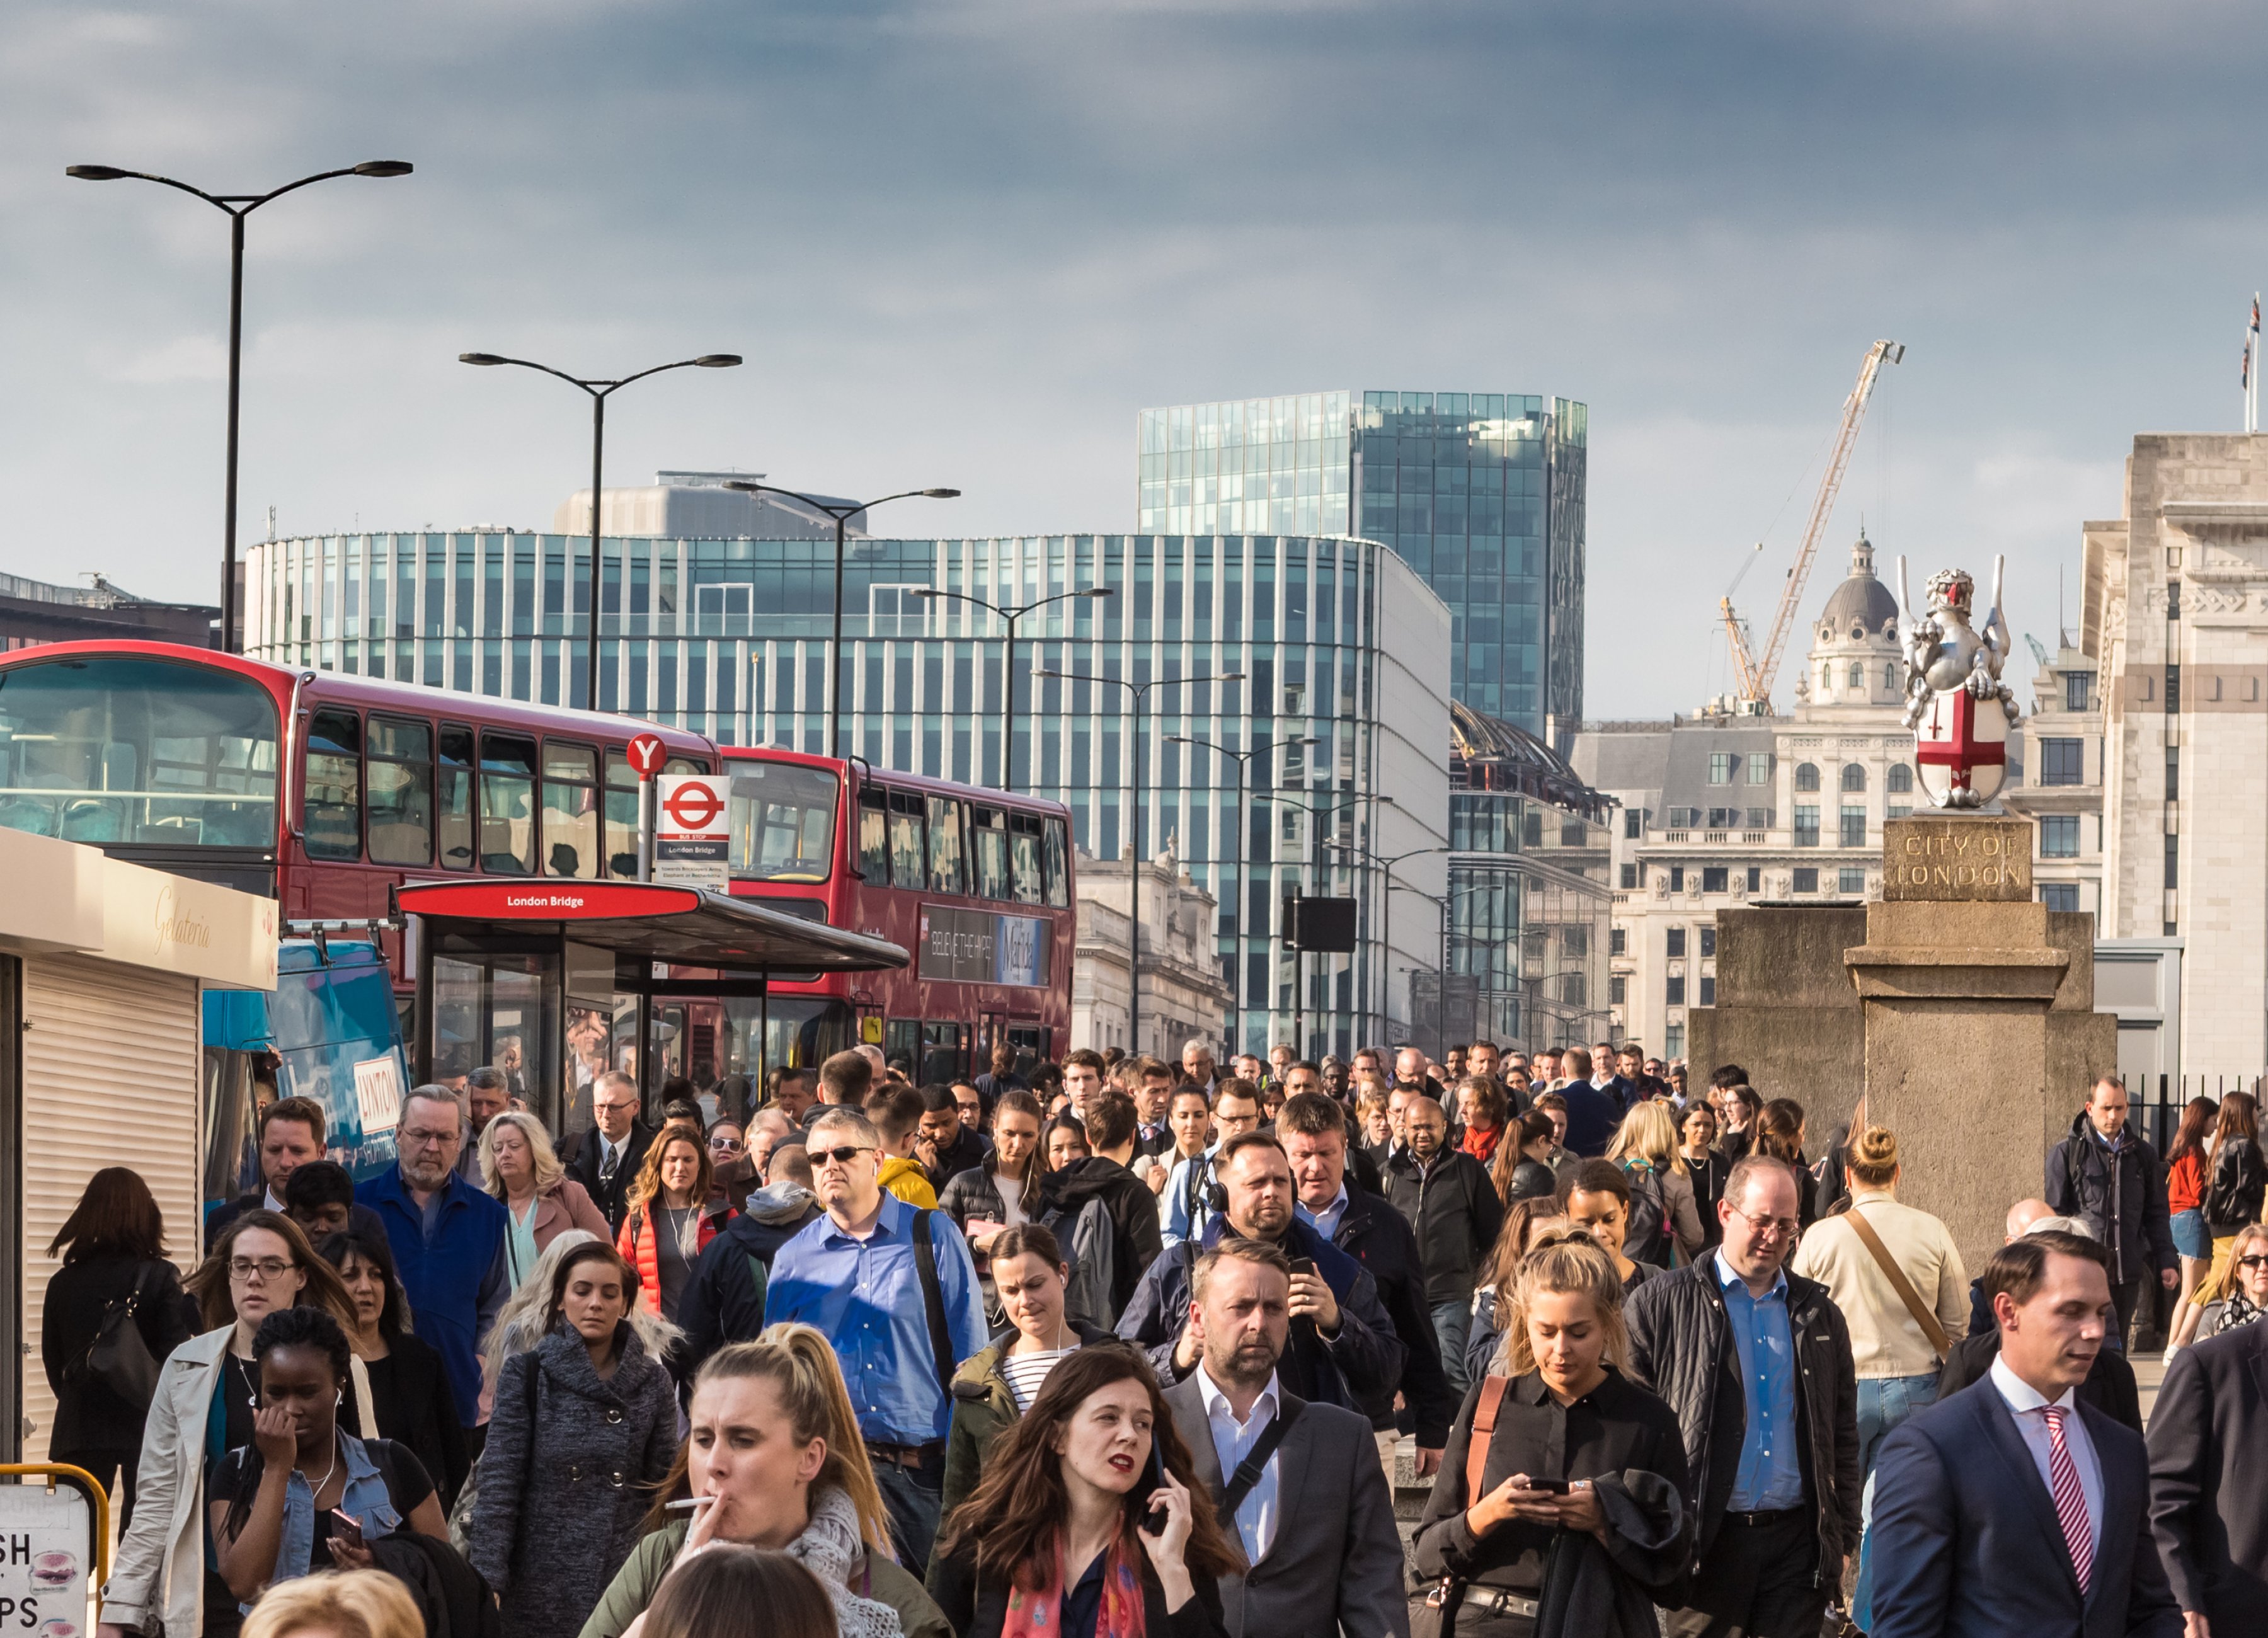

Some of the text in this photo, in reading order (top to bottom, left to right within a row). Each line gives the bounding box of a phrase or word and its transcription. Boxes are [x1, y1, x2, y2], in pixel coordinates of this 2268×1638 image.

[634, 740, 659, 769] Y
[694, 847, 716, 855] Bridge
[1906, 835, 2017, 856] CITY OF
[1897, 864, 2021, 885] LONDON
[508, 896, 583, 908] London Bridge
[154, 885, 210, 955] Gelateria
[959, 933, 974, 958] THE
[1002, 925, 1033, 971] Matilda
[358, 1069, 399, 1120] LYNTON
